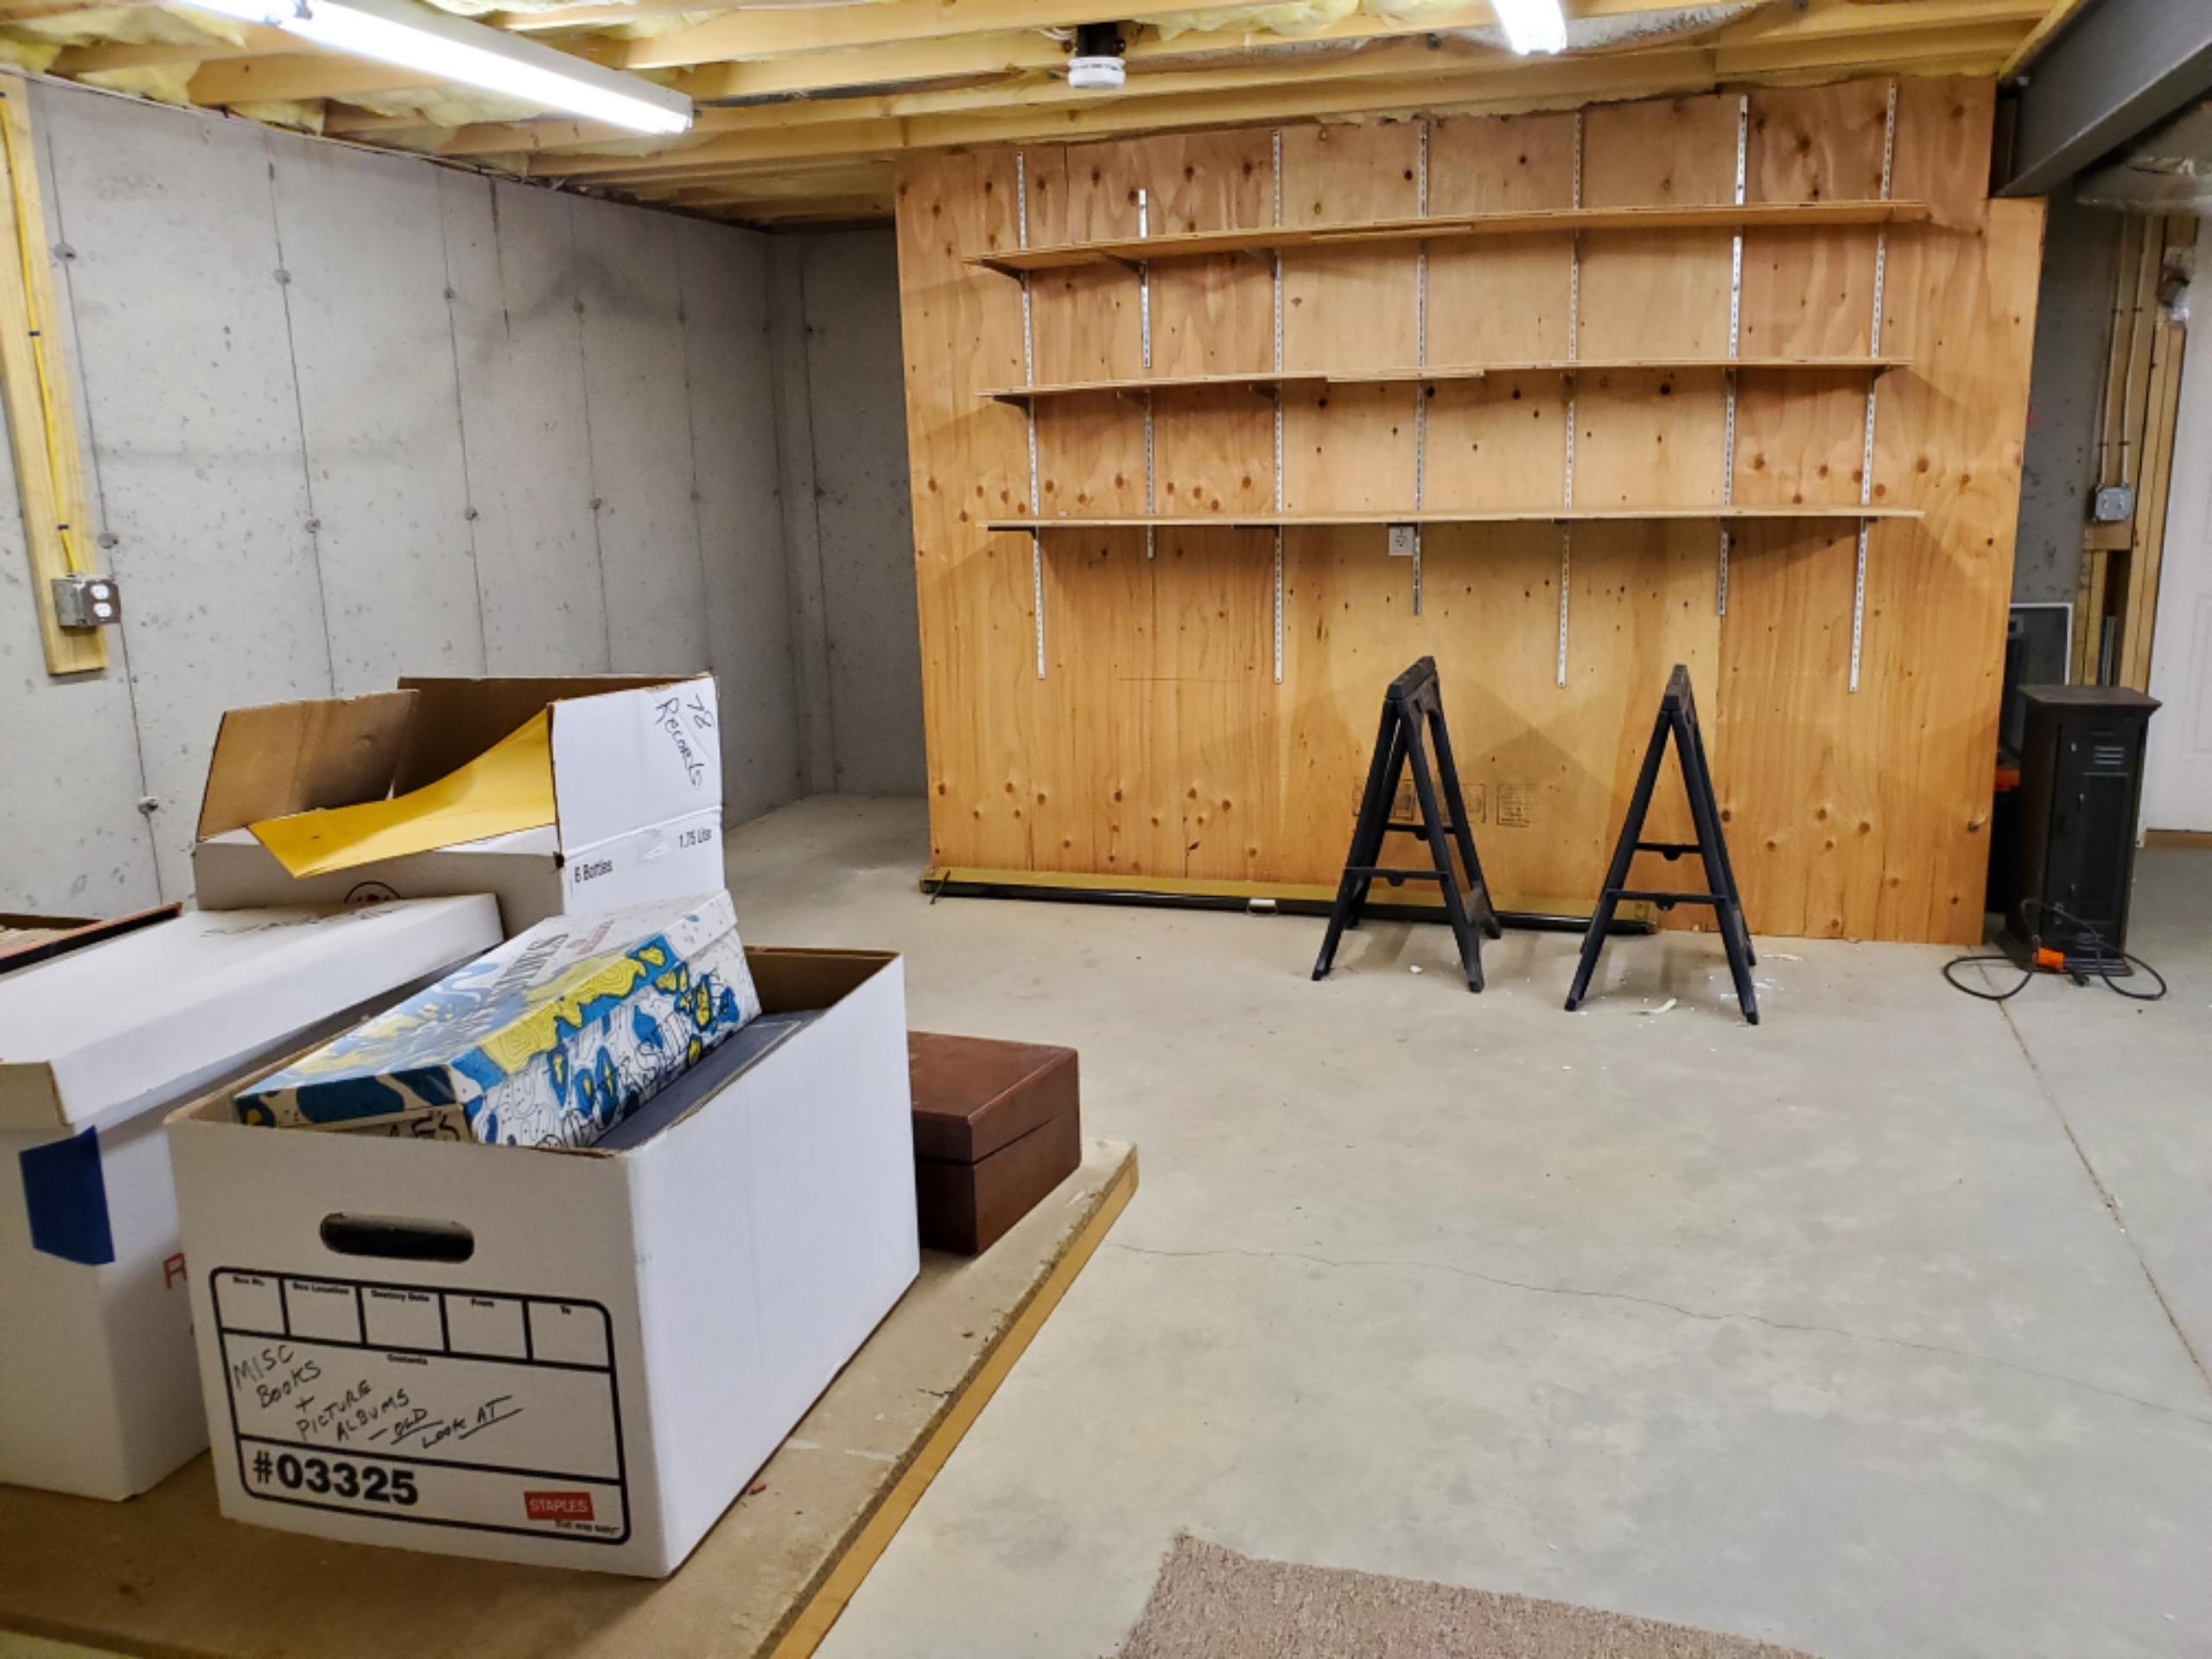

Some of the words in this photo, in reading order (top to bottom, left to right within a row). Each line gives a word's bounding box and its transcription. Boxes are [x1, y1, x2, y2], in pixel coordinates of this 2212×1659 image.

[574, 867, 582, 883] 6
[583, 860, 613, 881] Bottles
[311, 1285, 350, 1295] Location
[471, 1299, 494, 1308] From
[560, 1305, 571, 1315] To
[231, 1344, 295, 1389] MISC
[386, 1354, 429, 1365] Contents
[296, 1380, 372, 1440] PICTURE
[336, 1389, 410, 1442] ALBUMS
[253, 1451, 419, 1506] #03325
[529, 1497, 589, 1514] STAPLES
